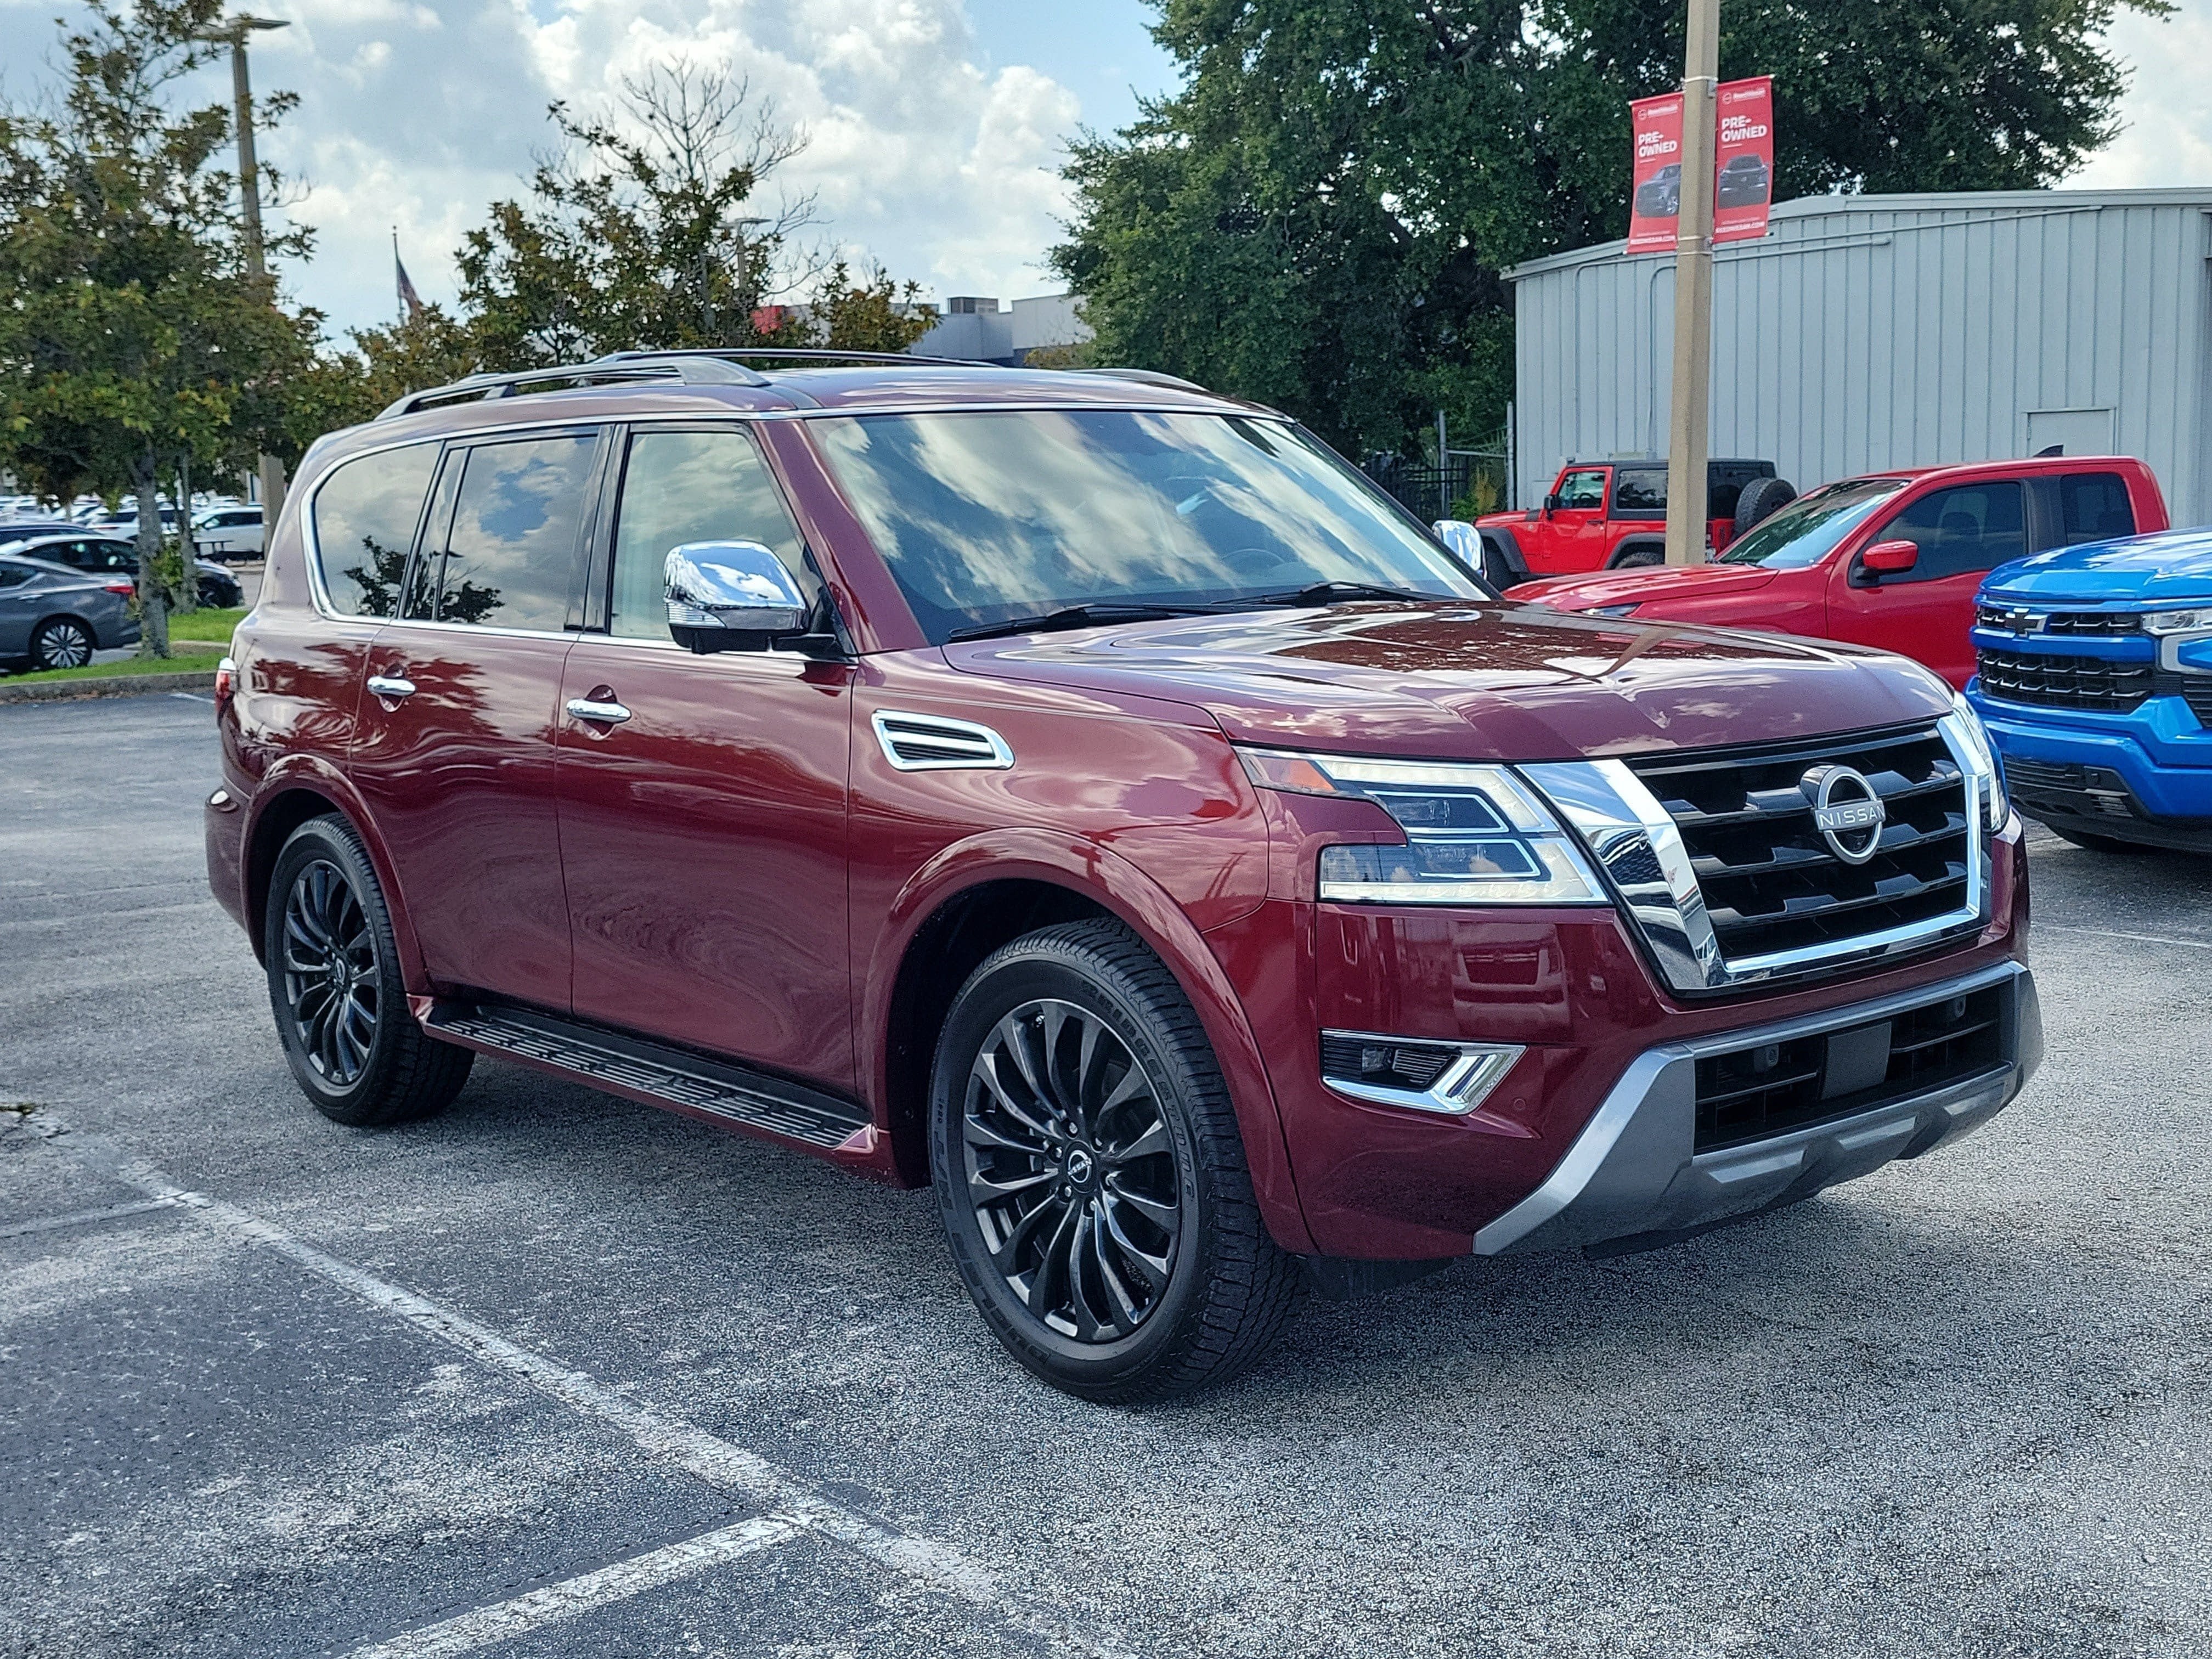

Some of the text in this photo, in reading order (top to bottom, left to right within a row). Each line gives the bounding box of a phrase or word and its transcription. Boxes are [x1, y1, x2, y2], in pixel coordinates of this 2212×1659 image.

[1722, 115, 1752, 130] PRE-
[1638, 131, 1664, 146] PRE-
[1721, 125, 1768, 142] OWNED
[1638, 140, 1678, 157] OWNED
[1819, 806, 1885, 827] NISSAN
